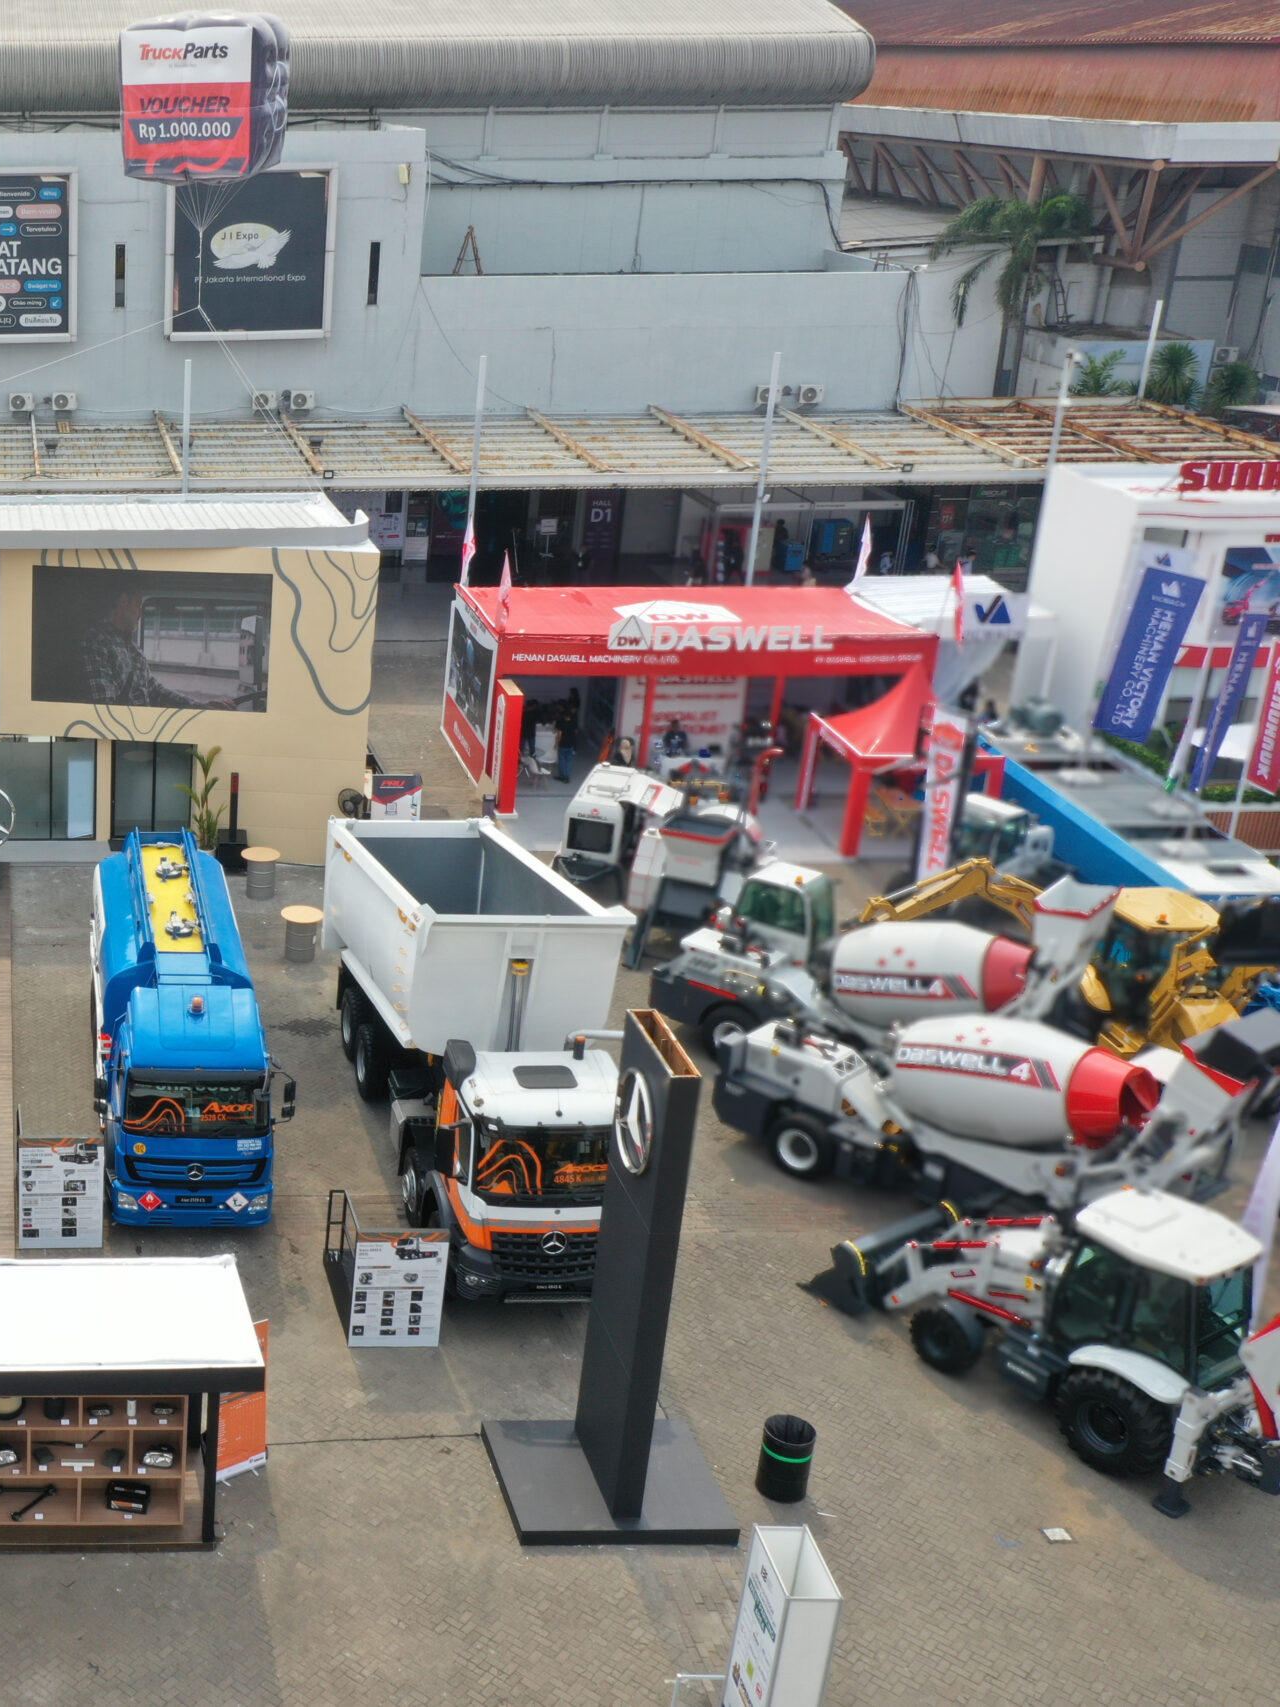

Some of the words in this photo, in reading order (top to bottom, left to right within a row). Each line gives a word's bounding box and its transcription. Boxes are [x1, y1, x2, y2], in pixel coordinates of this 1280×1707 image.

[140, 96, 230, 114] VOUCHER
[139, 123, 156, 140] Rp
[159, 122, 231, 138] 1.000.000
[236, 231, 259, 241] Expo
[205, 275, 234, 284] Jakarta
[236, 274, 286, 282] International
[287, 273, 306, 282] Expo
[591, 508, 612, 522] D1
[617, 637, 641, 647] DW
[653, 625, 834, 651] DASWELL
[1129, 607, 1163, 679] MACHINERY
[1147, 610, 1177, 664] HENAN
[512, 653, 546, 662] HENAN
[547, 654, 587, 663] DASWELL
[589, 655, 642, 663] MACHINERY
[1122, 667, 1156, 729] VICTORY
[1010, 1062, 1031, 1081] 4
